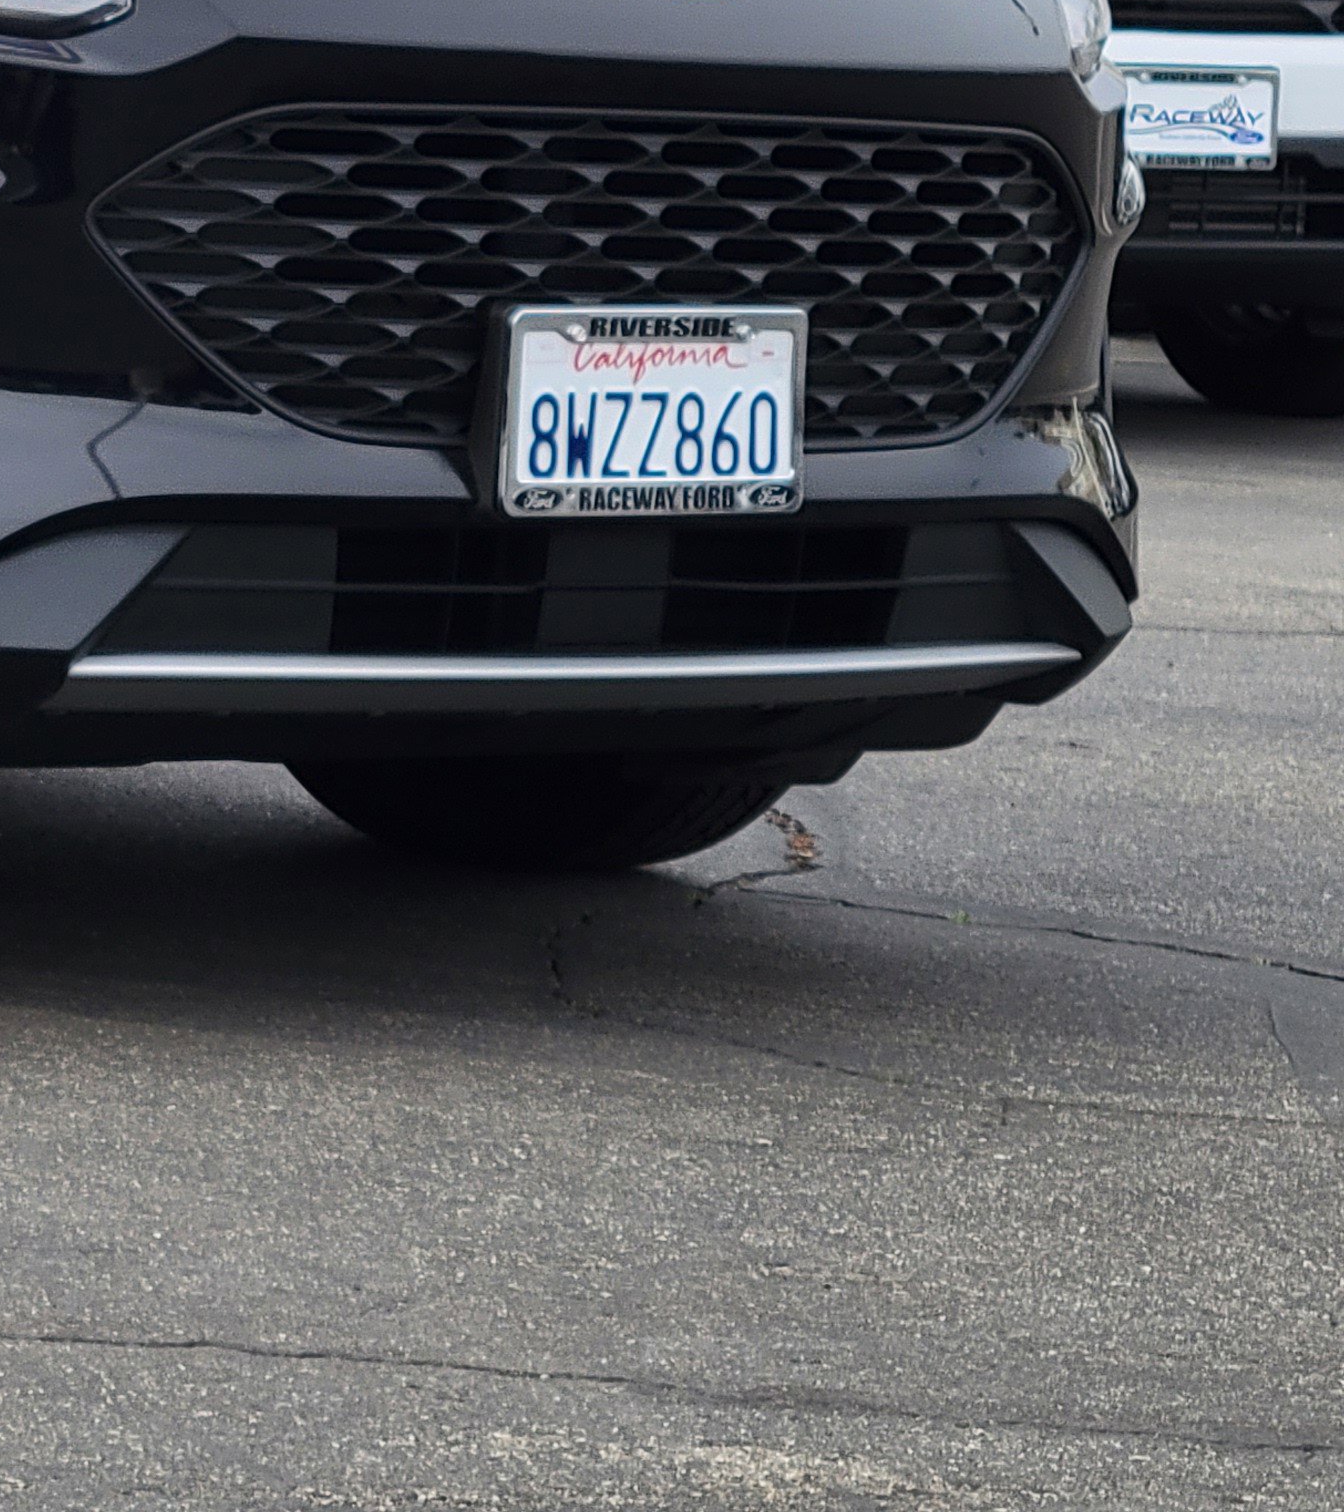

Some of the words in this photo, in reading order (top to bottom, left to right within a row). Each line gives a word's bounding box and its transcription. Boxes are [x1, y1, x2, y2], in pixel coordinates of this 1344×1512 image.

[588, 316, 736, 338] RIVERSIDE
[574, 342, 748, 385] California
[528, 391, 779, 479] 8WZZ860
[578, 486, 677, 511] RACEWAY
[682, 485, 735, 509] FORD
